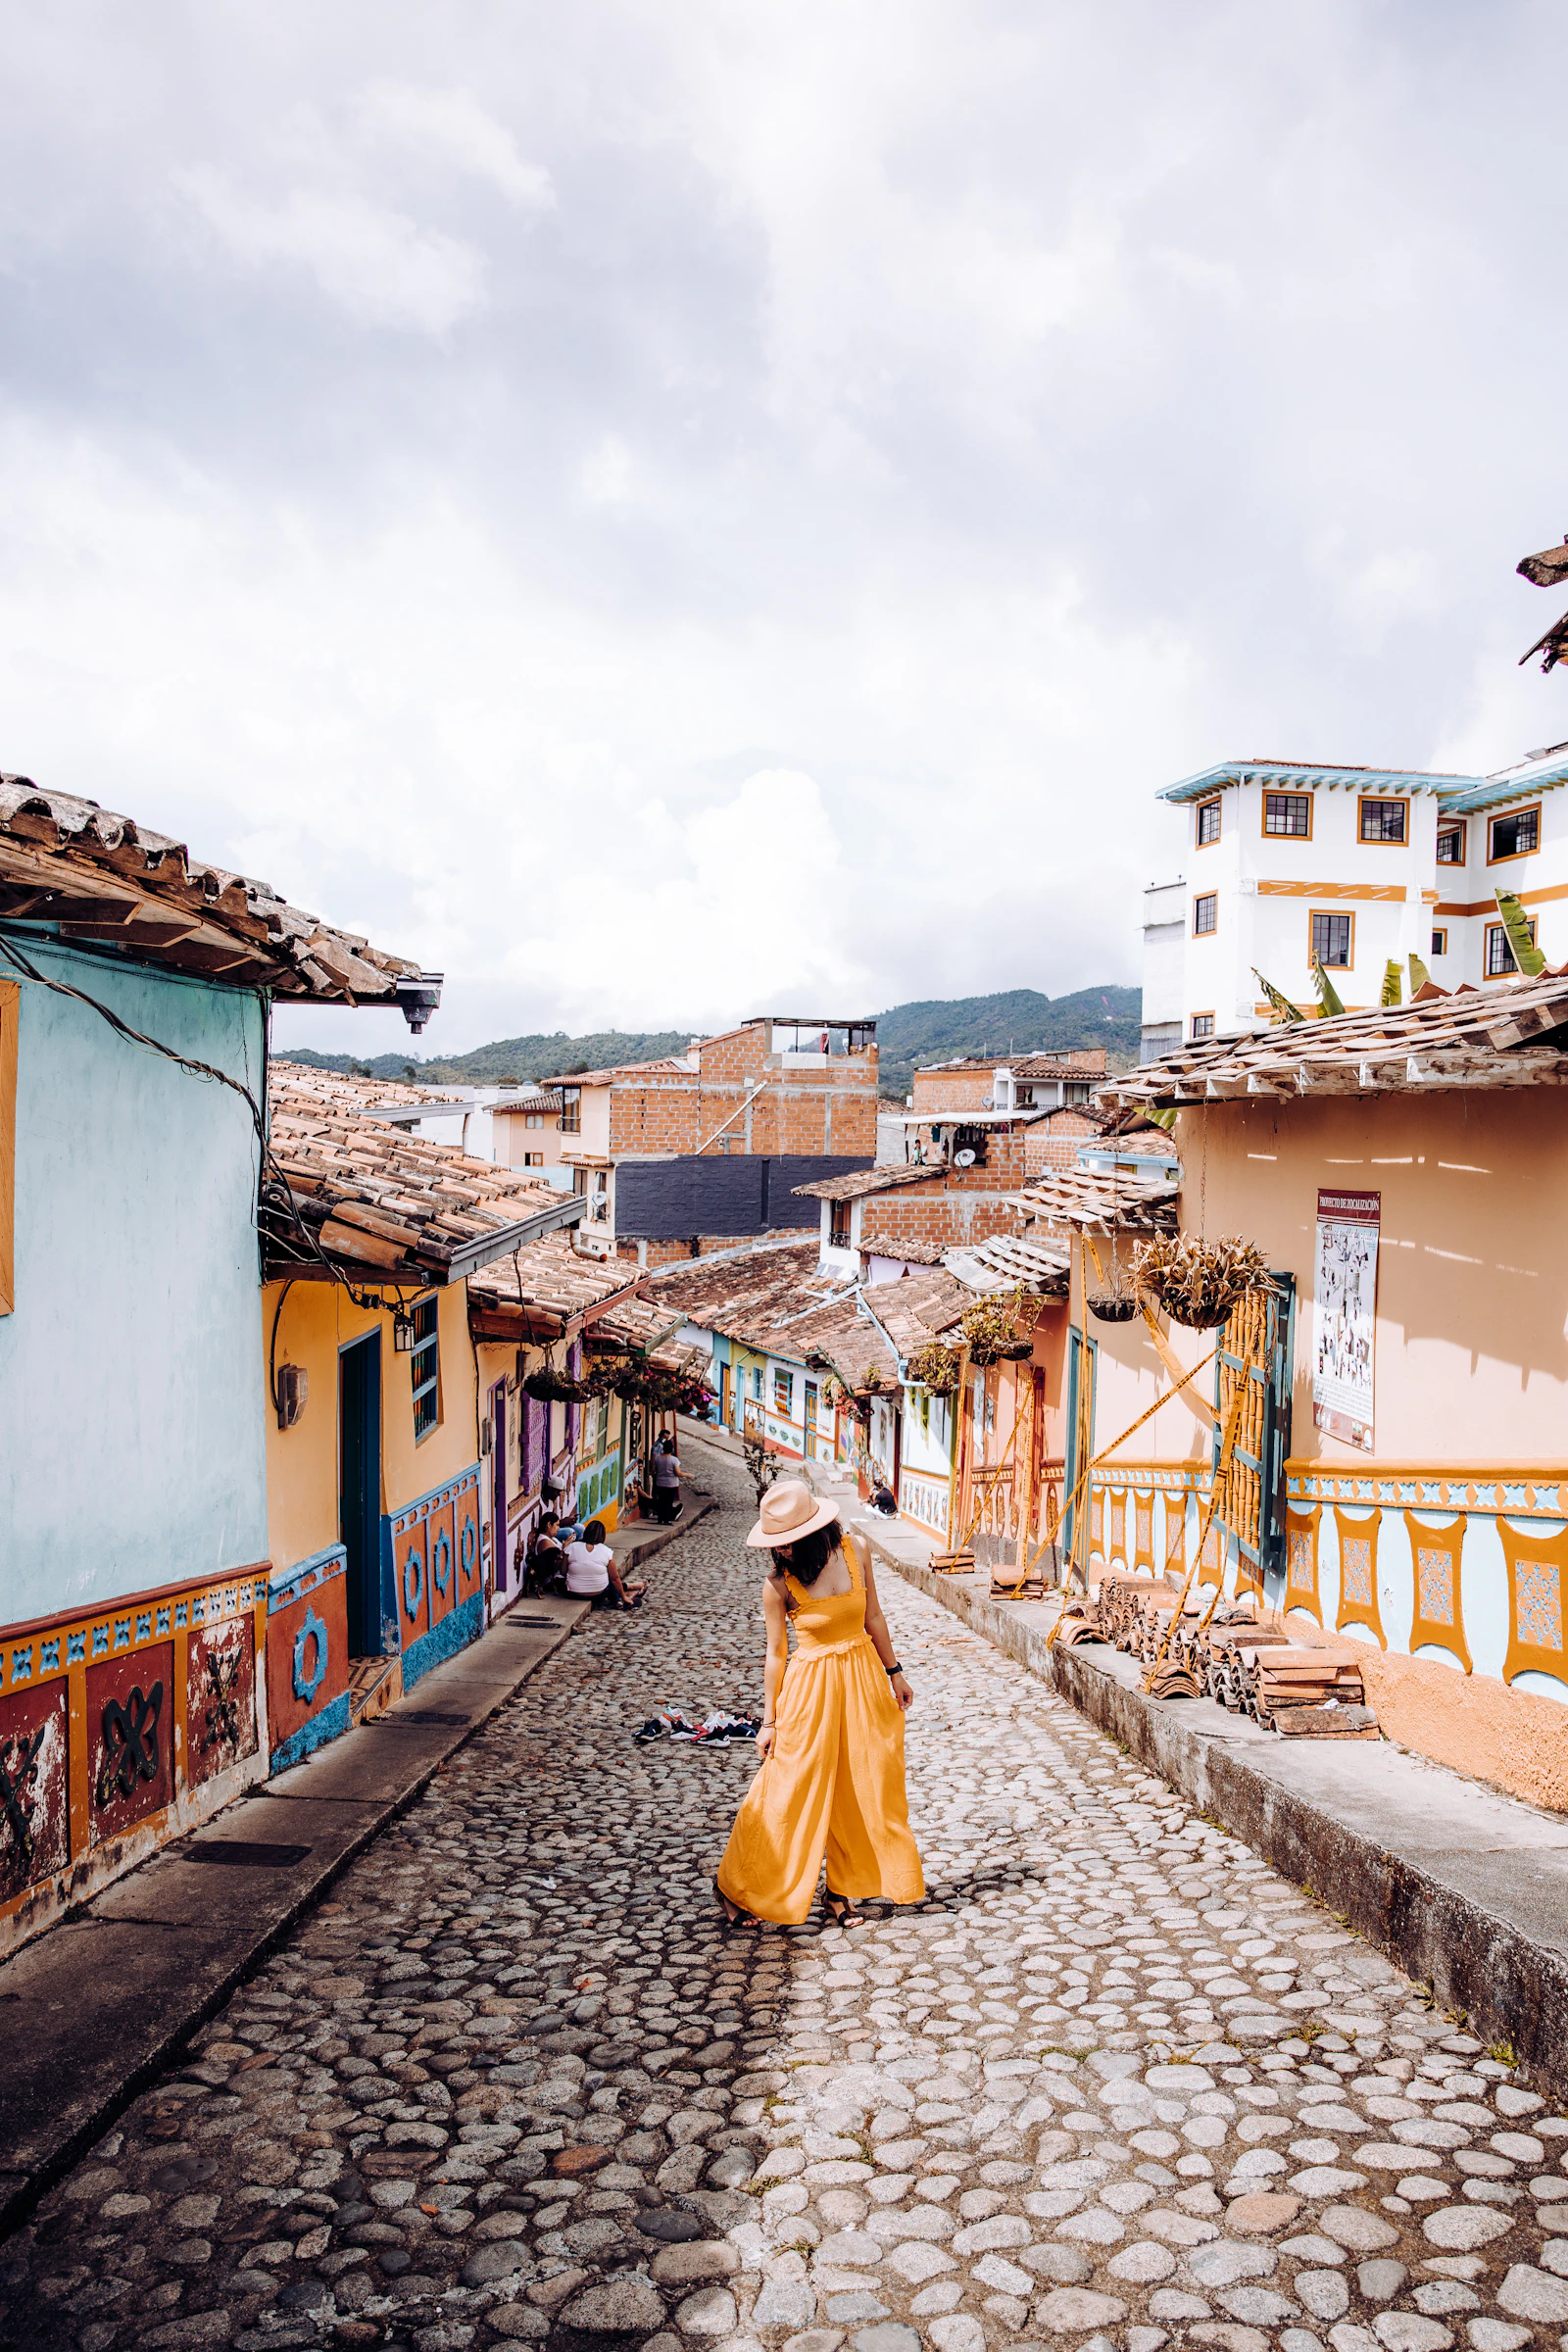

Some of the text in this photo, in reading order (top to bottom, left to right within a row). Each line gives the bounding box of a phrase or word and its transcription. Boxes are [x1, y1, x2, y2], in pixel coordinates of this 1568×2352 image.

[1319, 1197, 1379, 1211] PROYECTO DE ZOCALIZACIÓN
